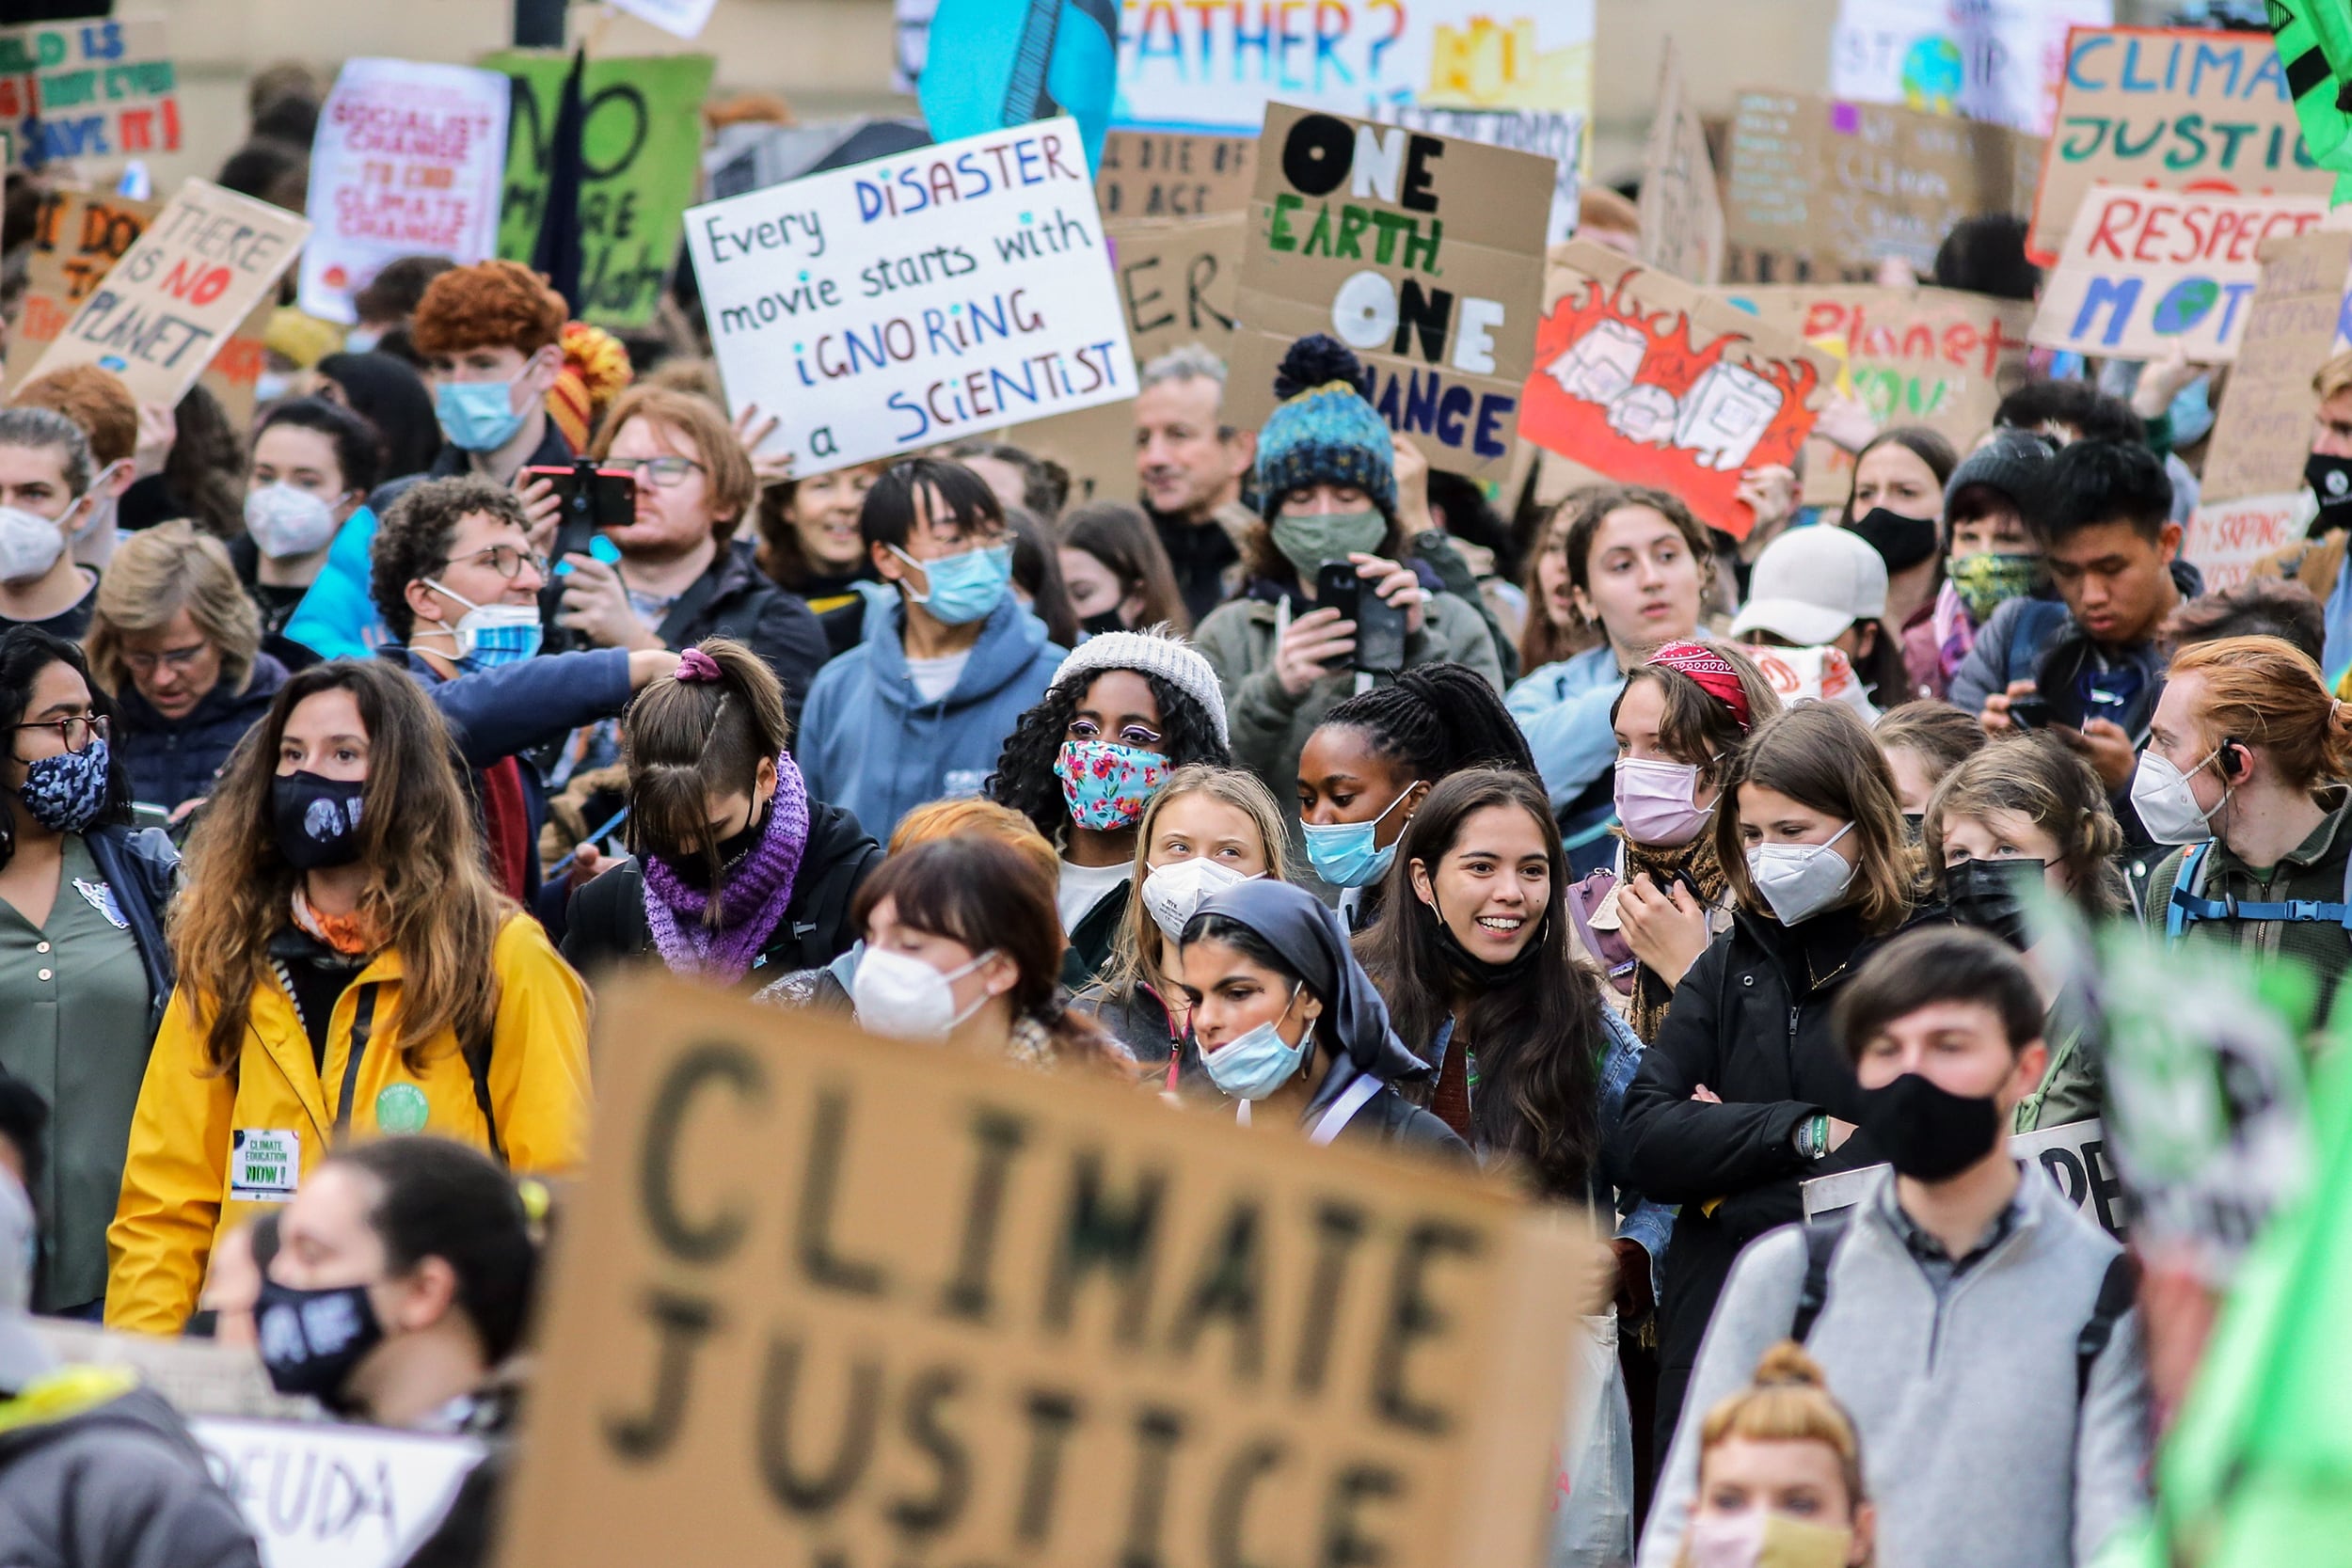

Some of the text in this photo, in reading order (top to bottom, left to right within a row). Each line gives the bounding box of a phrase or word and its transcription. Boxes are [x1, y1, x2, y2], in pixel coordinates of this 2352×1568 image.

[1282, 113, 1444, 214] ONE
[161, 201, 283, 274] THERE
[502, 183, 638, 239] MRE
[706, 210, 826, 263] Every
[118, 248, 165, 284] IS
[158, 259, 233, 307] NO
[720, 209, 1093, 335] movie starts with
[67, 291, 215, 369] PLANET
[1331, 270, 1505, 374] ONE
[809, 425, 840, 458] a
[245, 1151, 287, 1163] EDUCATION
[249, 1139, 283, 1151] CLIMATE
[636, 1035, 1489, 1439] CLIMATE
[597, 1285, 1404, 1568] JUSTICE
